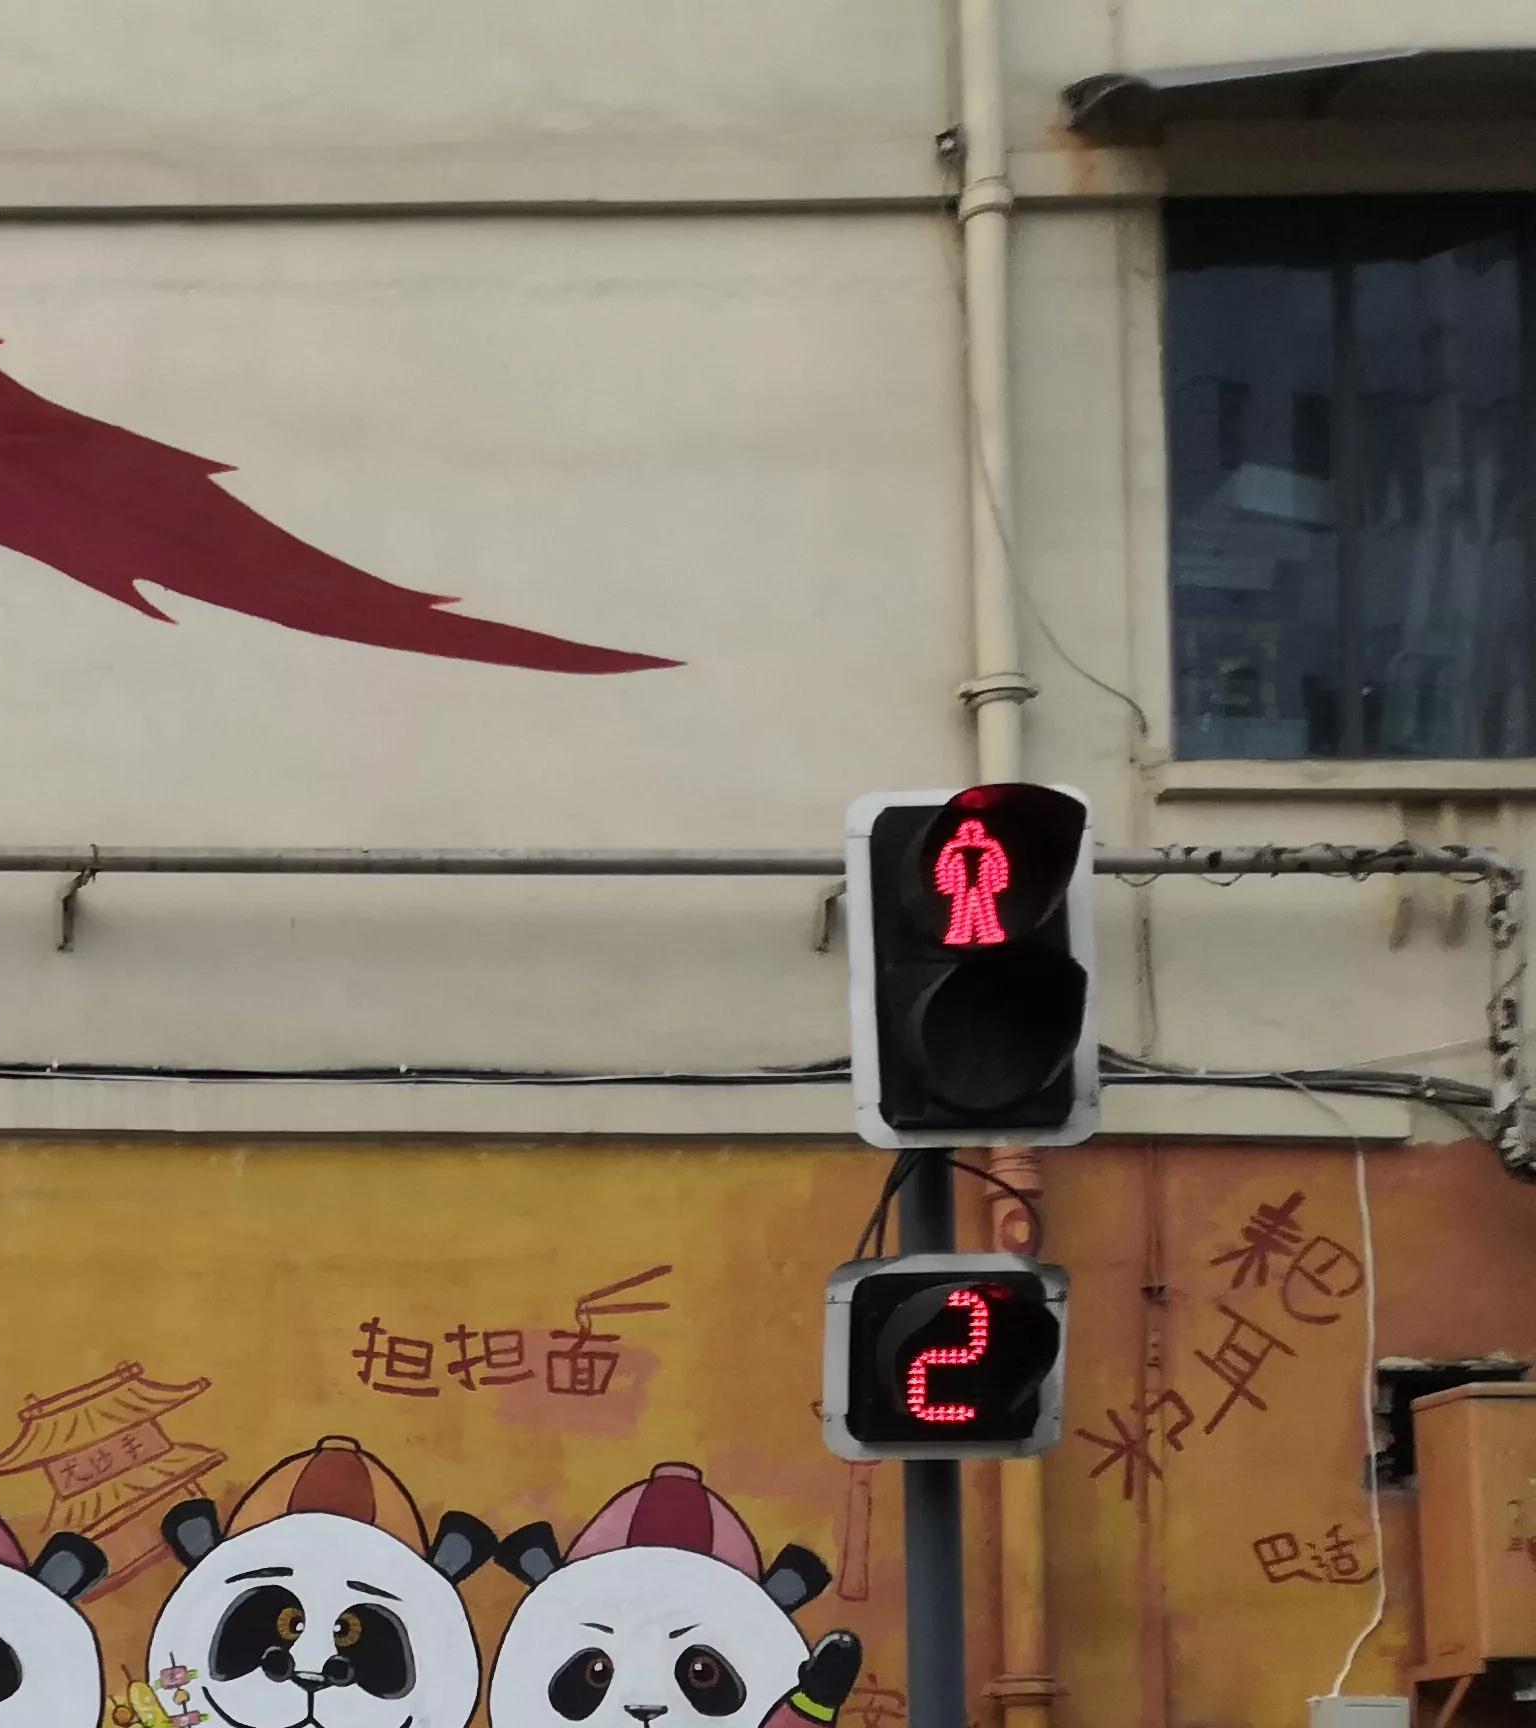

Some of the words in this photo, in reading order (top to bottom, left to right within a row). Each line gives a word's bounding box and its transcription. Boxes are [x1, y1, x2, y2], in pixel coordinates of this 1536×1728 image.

[352, 1316, 623, 1398] 担担面
[906, 1289, 989, 1424] 2
[1252, 1522, 1379, 1586] 巴适
